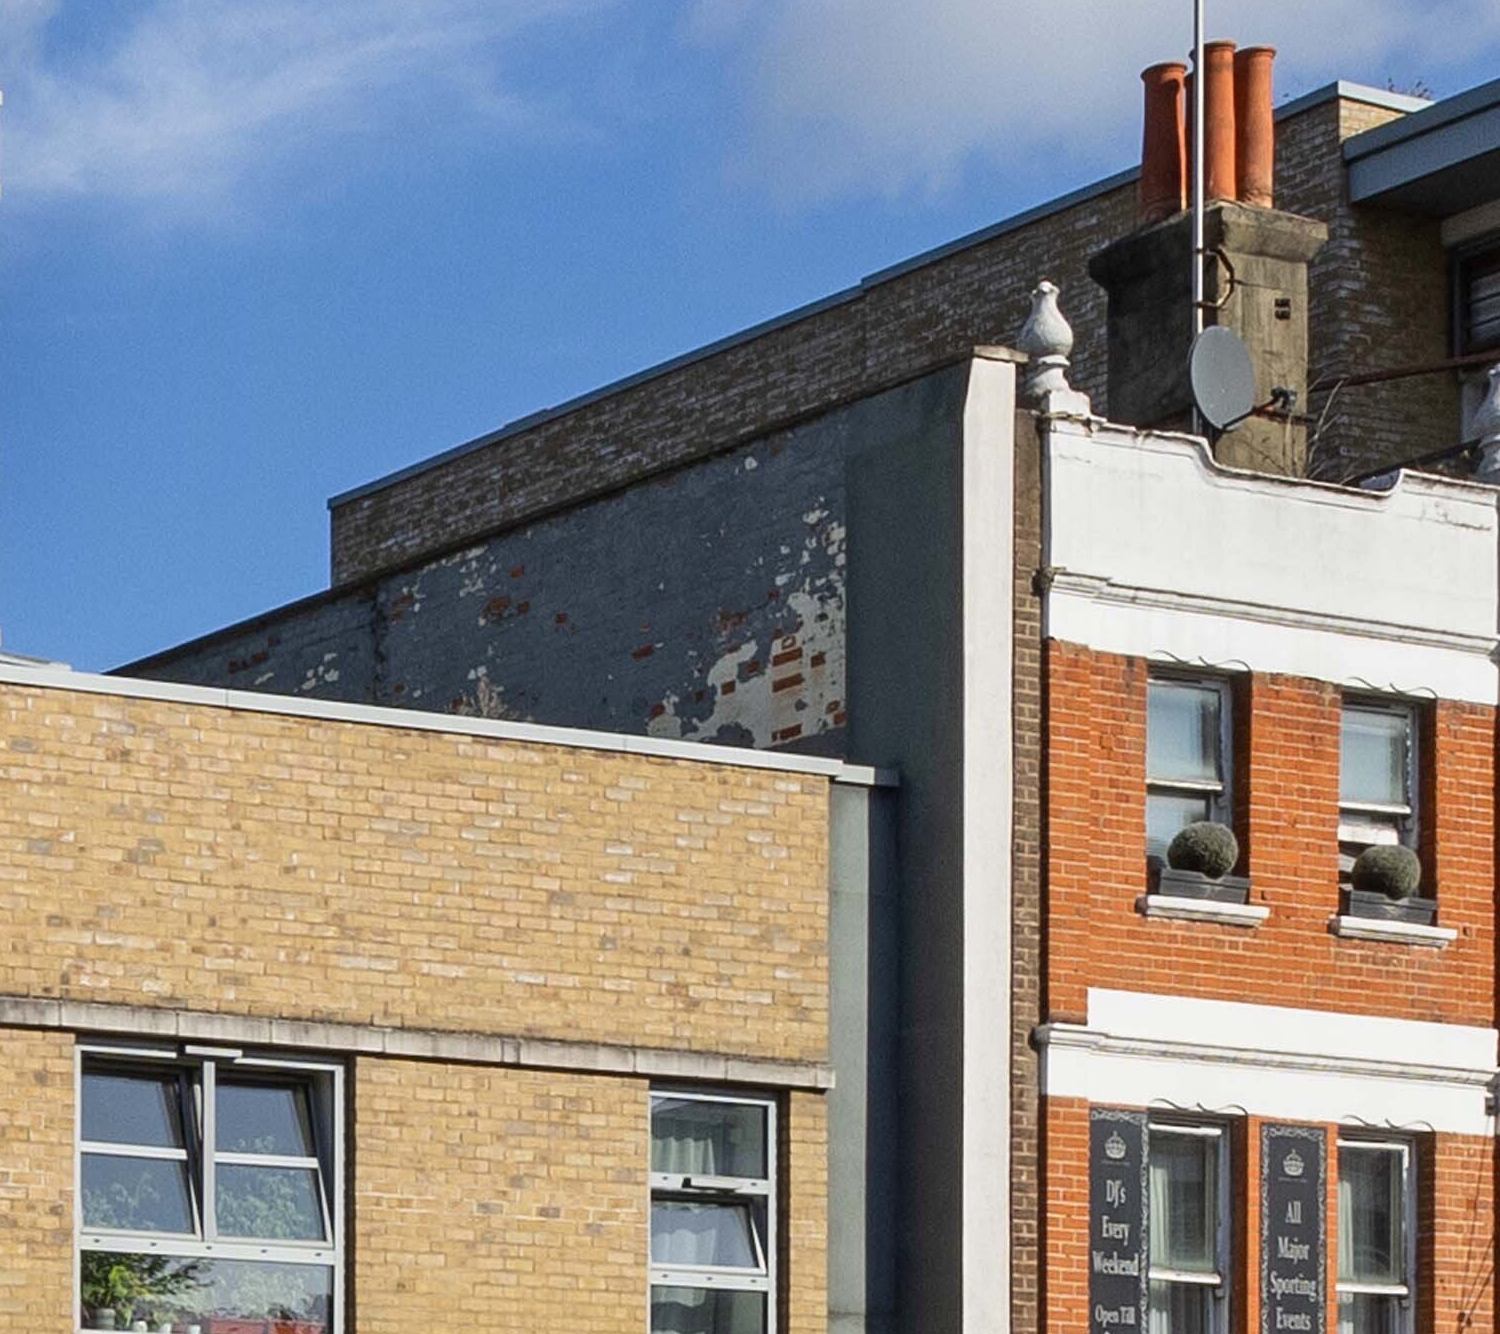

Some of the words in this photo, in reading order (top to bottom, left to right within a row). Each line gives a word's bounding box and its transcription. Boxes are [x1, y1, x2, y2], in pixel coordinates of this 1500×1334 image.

[1285, 1200, 1301, 1223] All
[1102, 1215, 1130, 1246] Every
[1093, 1251, 1139, 1276] Weekend
[1277, 1236, 1310, 1265] Major
[1270, 1271, 1317, 1302] Sporting
[1276, 1307, 1311, 1331] Events
